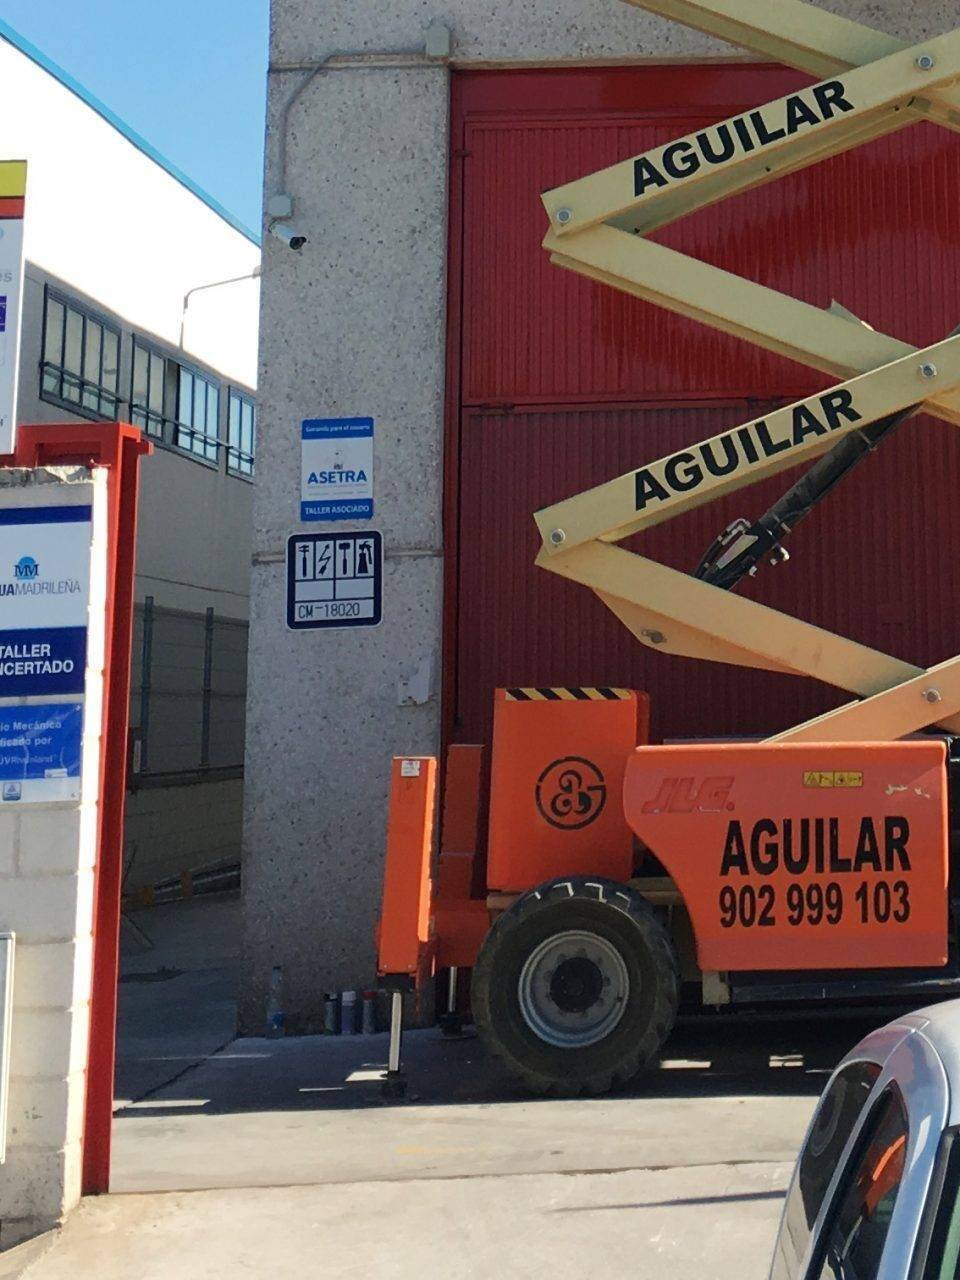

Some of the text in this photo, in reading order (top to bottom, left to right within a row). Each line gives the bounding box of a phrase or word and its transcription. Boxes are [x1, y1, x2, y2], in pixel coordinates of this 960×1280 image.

[632, 80, 854, 196] AGUILAR
[633, 388, 862, 511] AGUILAR
[308, 470, 367, 485] ASETRA
[304, 505, 370, 515] TALLER ASOCIADO
[34, 737, 52, 746] por
[719, 816, 911, 876] AGUILAR
[718, 880, 911, 928] 902 999 103
